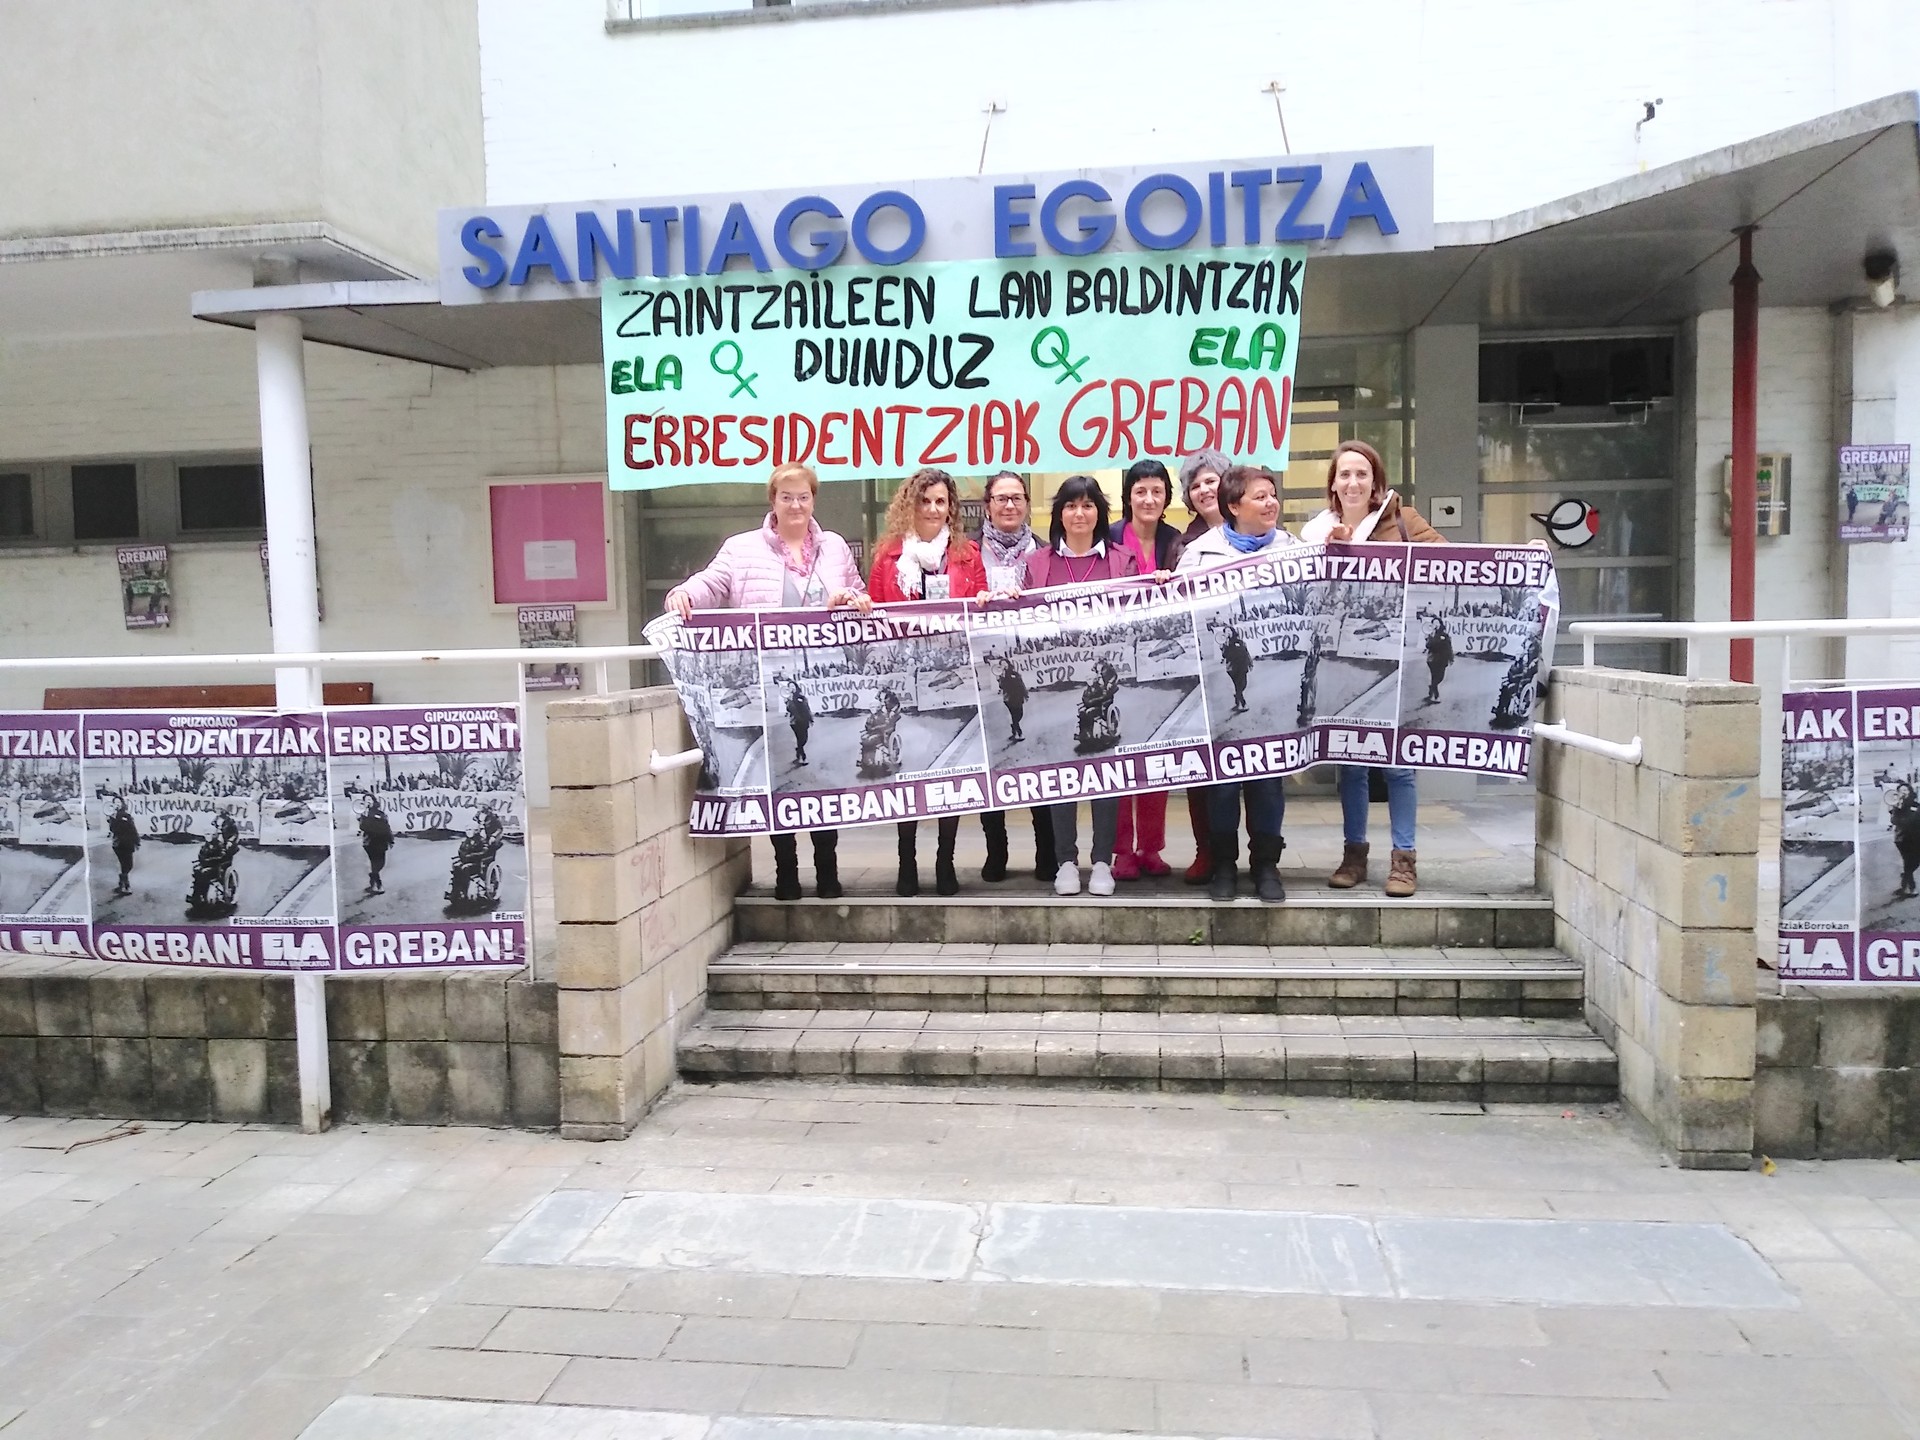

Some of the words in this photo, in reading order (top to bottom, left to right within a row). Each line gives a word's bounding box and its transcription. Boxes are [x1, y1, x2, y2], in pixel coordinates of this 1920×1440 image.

[461, 190, 926, 289] SANTIAGO
[994, 161, 1399, 258] EGOITZA
[969, 270, 1051, 319] LAN
[1067, 258, 1303, 316] BALDINTZAK
[611, 354, 682, 394] ELA
[795, 332, 994, 389] DUINDUZ
[1189, 322, 1287, 371] ELA
[624, 399, 1040, 470] ERRESIDENTZIAK
[1059, 376, 1291, 461] GREBAN
[1841, 451, 1909, 464] GREBAN!!
[118, 549, 167, 563] GREBAN!!
[1266, 545, 1327, 562] GIPUZKOAKO
[1196, 556, 1402, 599] ERRESIDENTZIAK
[1044, 585, 1104, 603] GIPUZKOAKO
[972, 581, 1185, 629] ERRESIDENTZIAK
[519, 609, 574, 623] GREBAN!!
[764, 614, 963, 648] ERRESIDENTZIAK
[1261, 634, 1300, 653] STOP
[1466, 636, 1508, 651] STOP
[1036, 665, 1075, 685] STOP
[822, 693, 859, 710] STOP
[169, 717, 238, 728] GIPUZKOAKO
[424, 710, 498, 723] GIPUZKOAKO
[88, 726, 322, 756] ERRESIDENTZIAK
[334, 722, 518, 753] ERRESIDENT
[1117, 737, 1204, 753] #ErresidentziakBorrokan
[1220, 731, 1320, 776] GREBAN!
[1328, 730, 1388, 756] ELA
[1401, 734, 1531, 772] GREBAN!
[899, 766, 982, 780] #ErresidentziakBorrokan
[996, 759, 1137, 804] GREBAN!
[1145, 750, 1207, 780] ELA
[1171, 774, 1208, 783] SINDIKATUA
[777, 786, 916, 827] GREBAN!
[925, 778, 985, 807] ELA
[950, 801, 985, 810] SINDIKATUA
[150, 814, 193, 832] STOP
[405, 810, 453, 830] STOP
[233, 917, 329, 926] #ErresidentziakBorrokan
[21, 931, 89, 954] ELA
[99, 932, 253, 965] GREBAN!
[262, 933, 331, 960] ELA
[345, 928, 514, 966] GREBAN!
